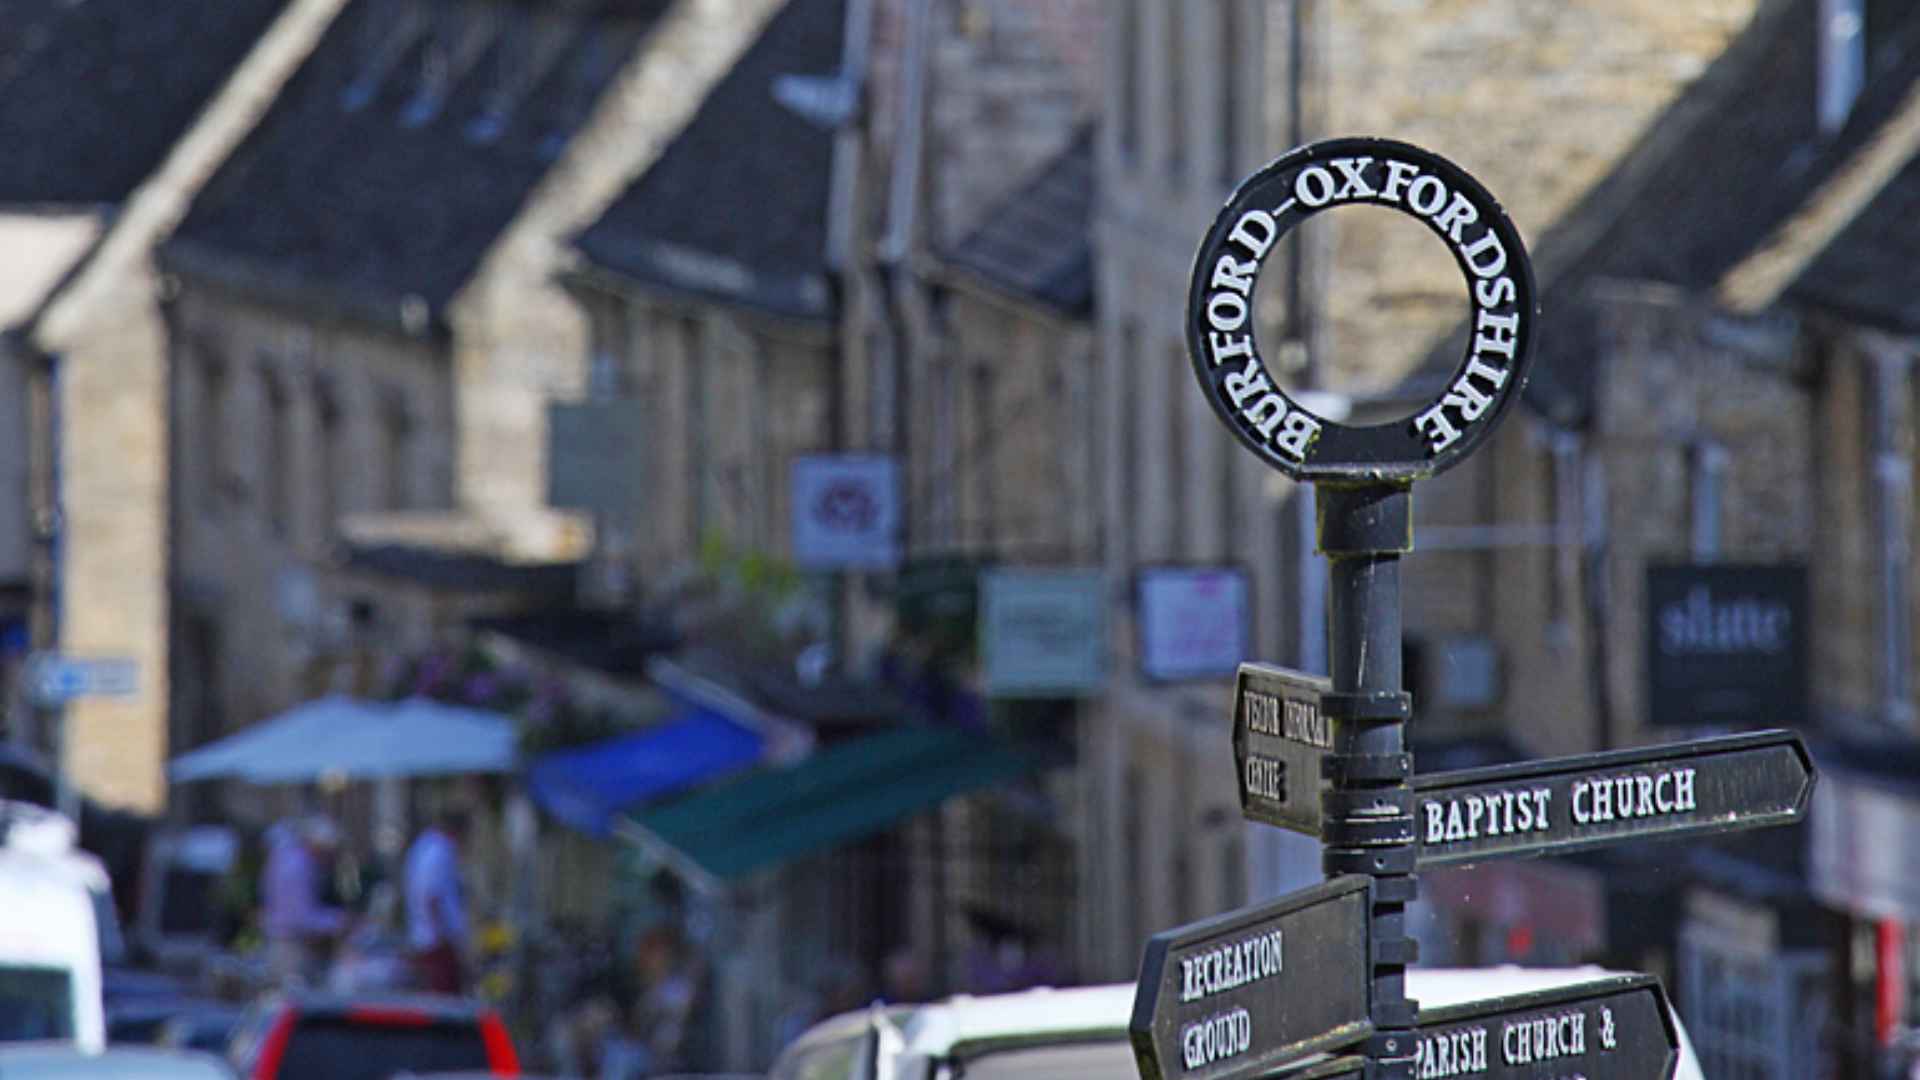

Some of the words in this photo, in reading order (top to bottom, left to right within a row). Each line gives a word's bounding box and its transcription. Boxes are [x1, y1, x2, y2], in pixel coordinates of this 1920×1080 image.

[1425, 787, 1551, 843] BAPTIST
[1571, 767, 1697, 824] CHURCH
[1181, 930, 1283, 1001] RECREATION
[1182, 1008, 1250, 1070] GROUND
[1502, 1011, 1586, 1065] CHURCH
[1601, 1007, 1617, 1049] &
